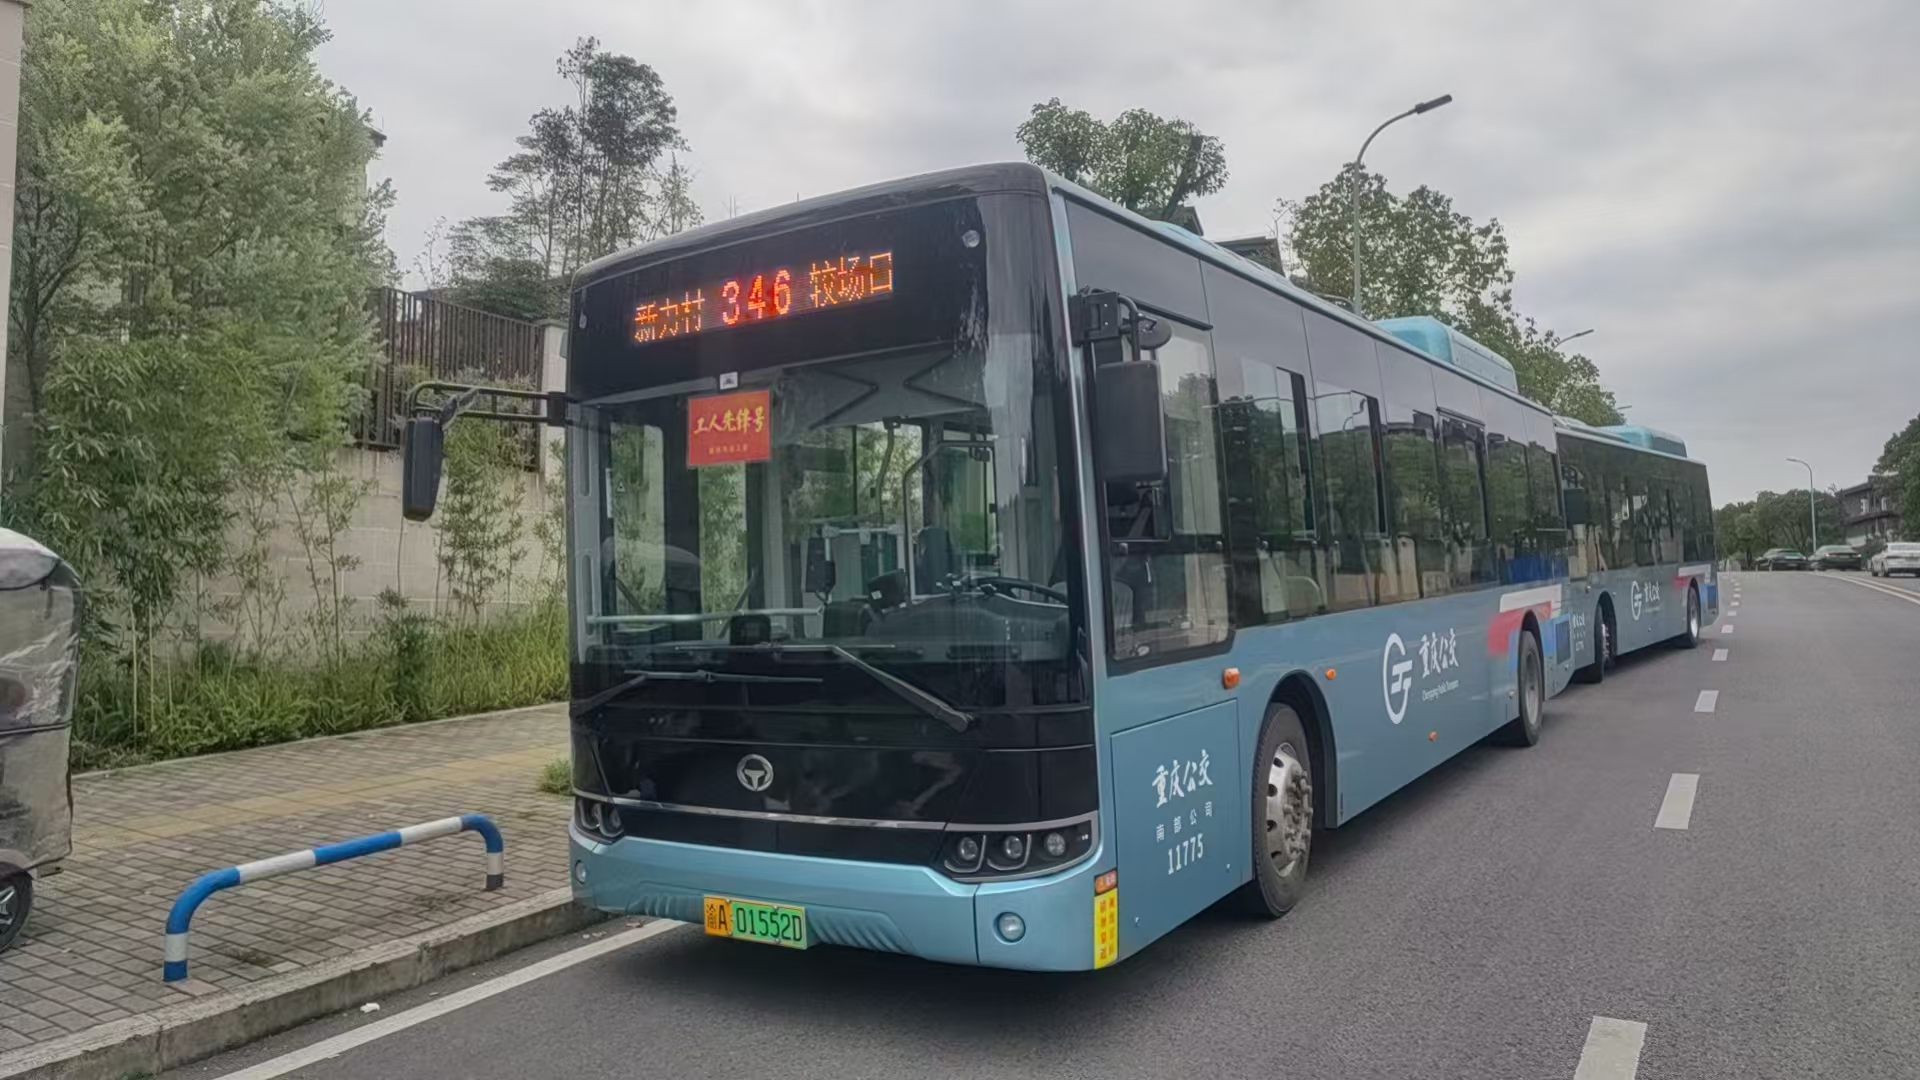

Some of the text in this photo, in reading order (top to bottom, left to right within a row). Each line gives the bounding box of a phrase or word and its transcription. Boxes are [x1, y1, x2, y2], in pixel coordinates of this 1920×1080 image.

[634, 252, 893, 343] 新力村 346 较场口
[693, 405, 765, 434] 工人先锋号
[1418, 627, 1460, 679] 重庆公交
[1151, 748, 1214, 809] 重庆公交
[1167, 833, 1204, 875] 11775
